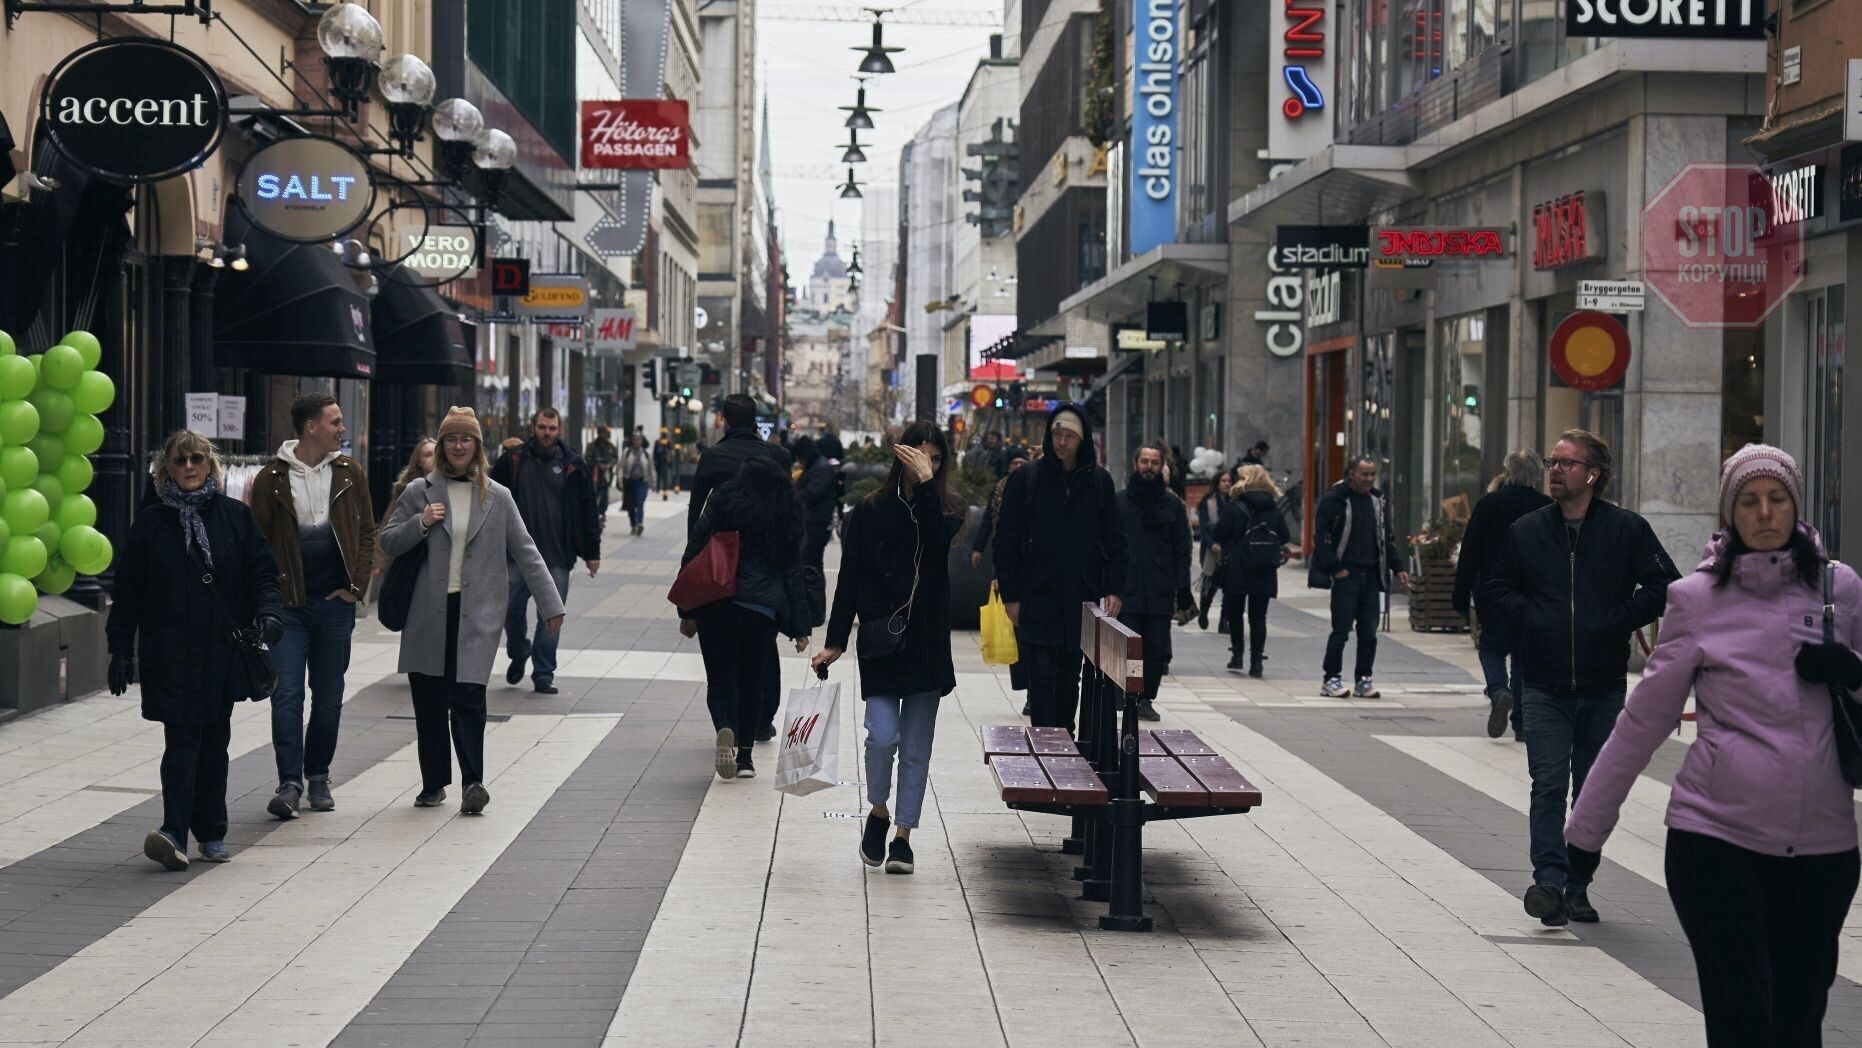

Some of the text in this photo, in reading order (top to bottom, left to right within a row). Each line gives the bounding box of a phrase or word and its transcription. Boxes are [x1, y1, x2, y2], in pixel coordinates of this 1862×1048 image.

[58, 93, 209, 127] accent
[589, 109, 682, 144] Hötorgs
[593, 143, 677, 156] PASSAGEN
[1138, 124, 1172, 200] clas
[257, 174, 355, 200] SALT
[1771, 164, 1817, 227] SCORETT
[408, 234, 470, 251] VERO
[1282, 243, 1370, 264] stadium
[402, 253, 472, 270] MODA
[496, 264, 522, 290] D
[191, 412, 213, 422] 50%
[785, 713, 820, 750] H&M
